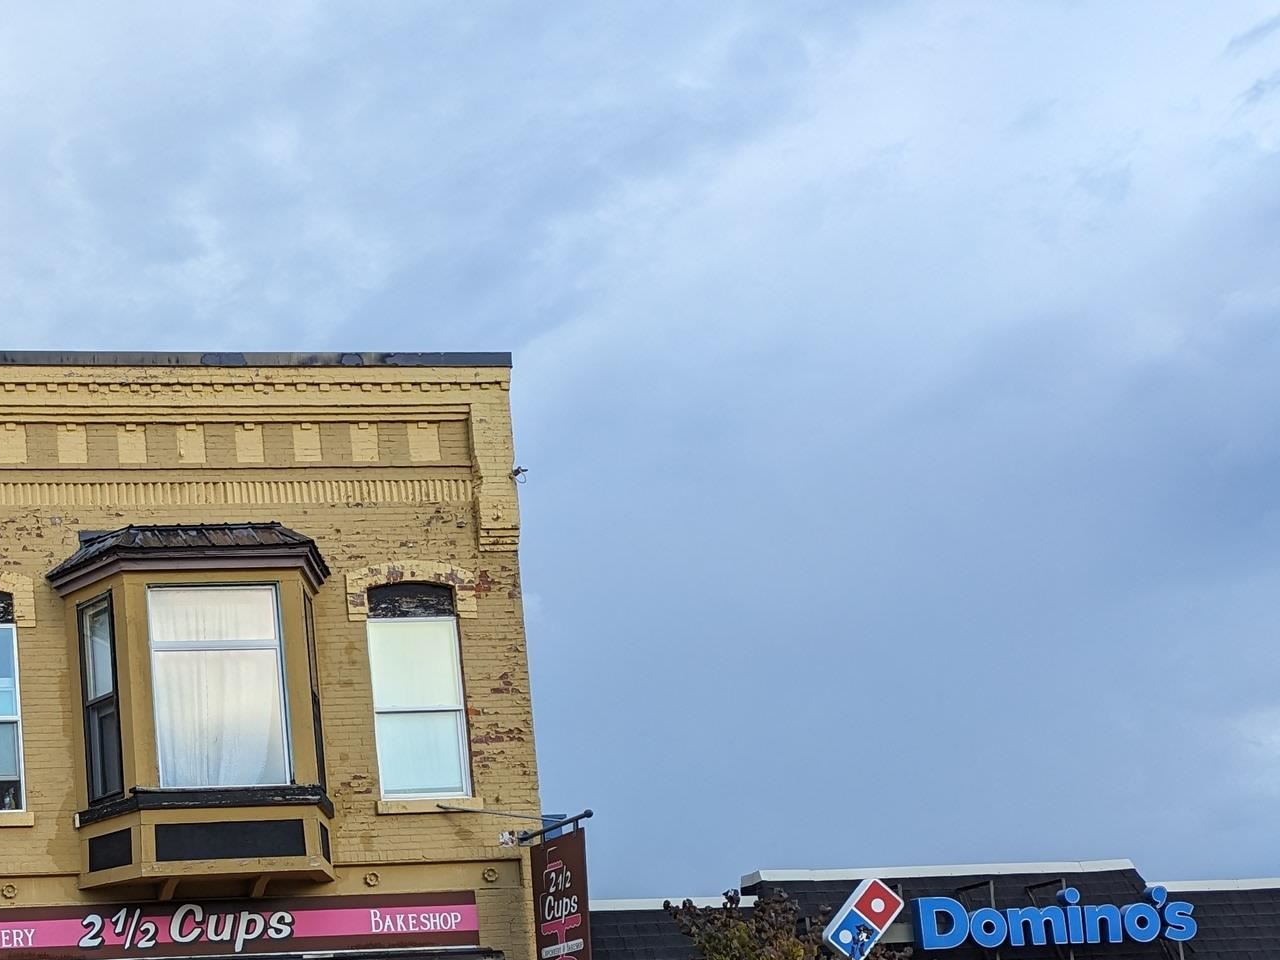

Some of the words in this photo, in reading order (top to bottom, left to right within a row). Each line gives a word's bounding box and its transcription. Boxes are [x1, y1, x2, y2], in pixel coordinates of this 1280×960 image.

[169, 903, 294, 953] Cups
[370, 908, 462, 934] BAKESHOP
[545, 895, 578, 924] Cups
[913, 885, 1198, 951] Domino's
